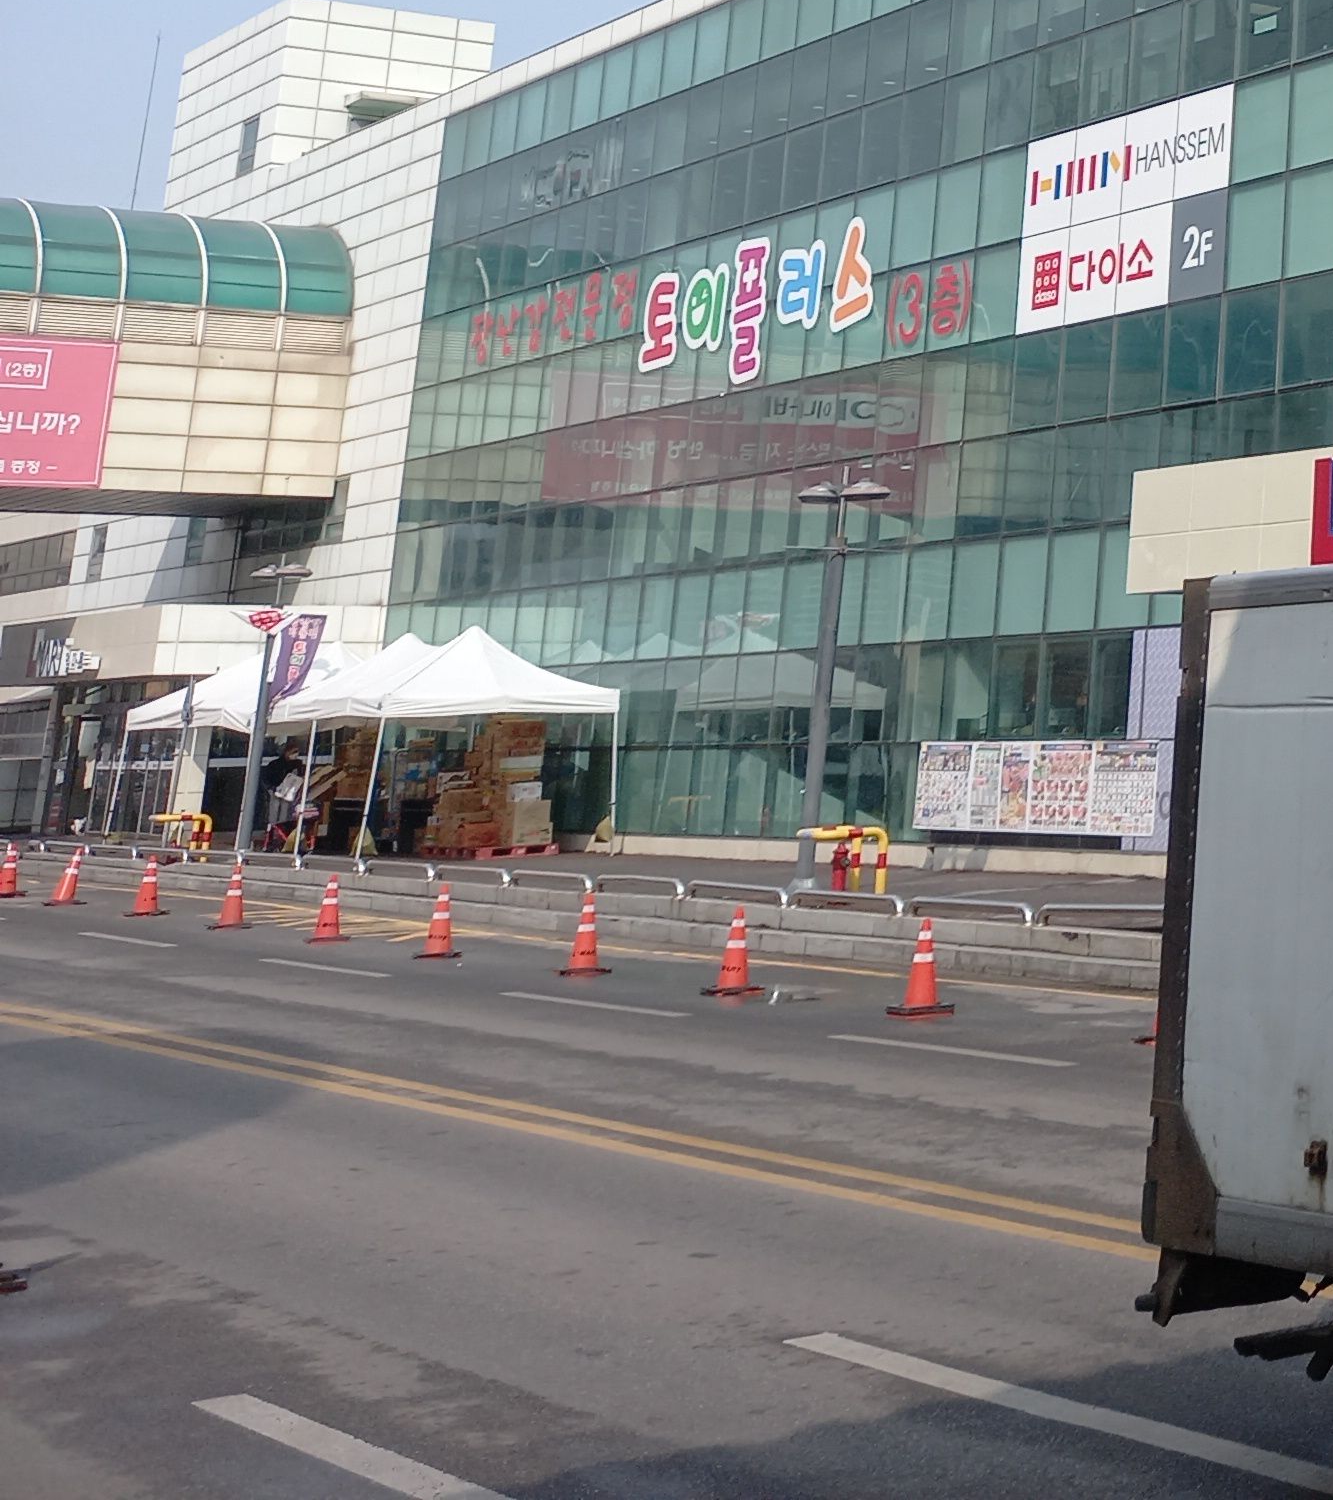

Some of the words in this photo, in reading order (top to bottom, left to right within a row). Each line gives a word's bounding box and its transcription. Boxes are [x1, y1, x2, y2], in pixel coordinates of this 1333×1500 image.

[1135, 122, 1226, 176] HANSSEM
[1068, 238, 1154, 293] 다이소
[1181, 224, 1214, 270] 2F
[638, 216, 873, 386] 토이플러스
[886, 260, 972, 348] (3층)
